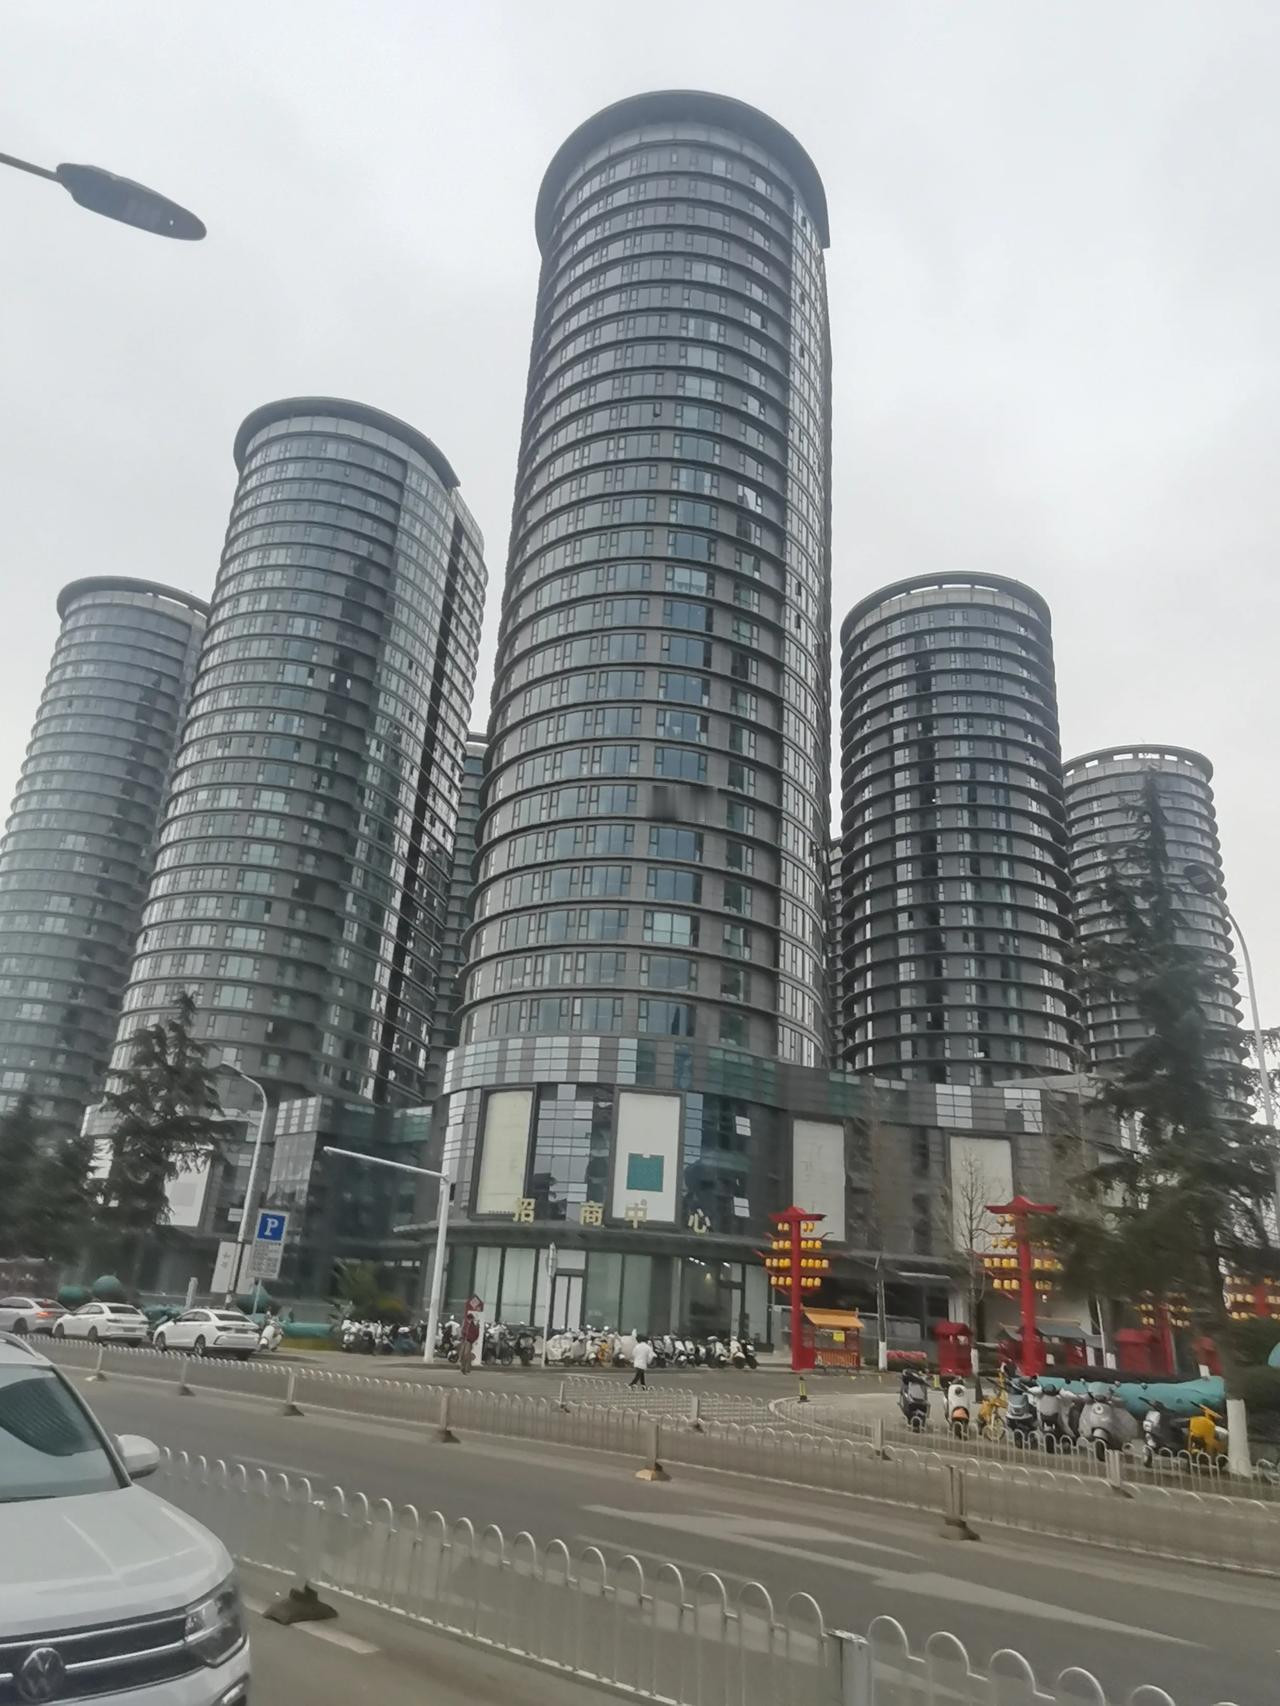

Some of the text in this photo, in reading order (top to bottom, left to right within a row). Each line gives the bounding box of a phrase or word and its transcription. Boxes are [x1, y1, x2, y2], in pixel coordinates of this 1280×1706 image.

[264, 1217, 279, 1236] P
[513, 1197, 711, 1233] 招商中心
